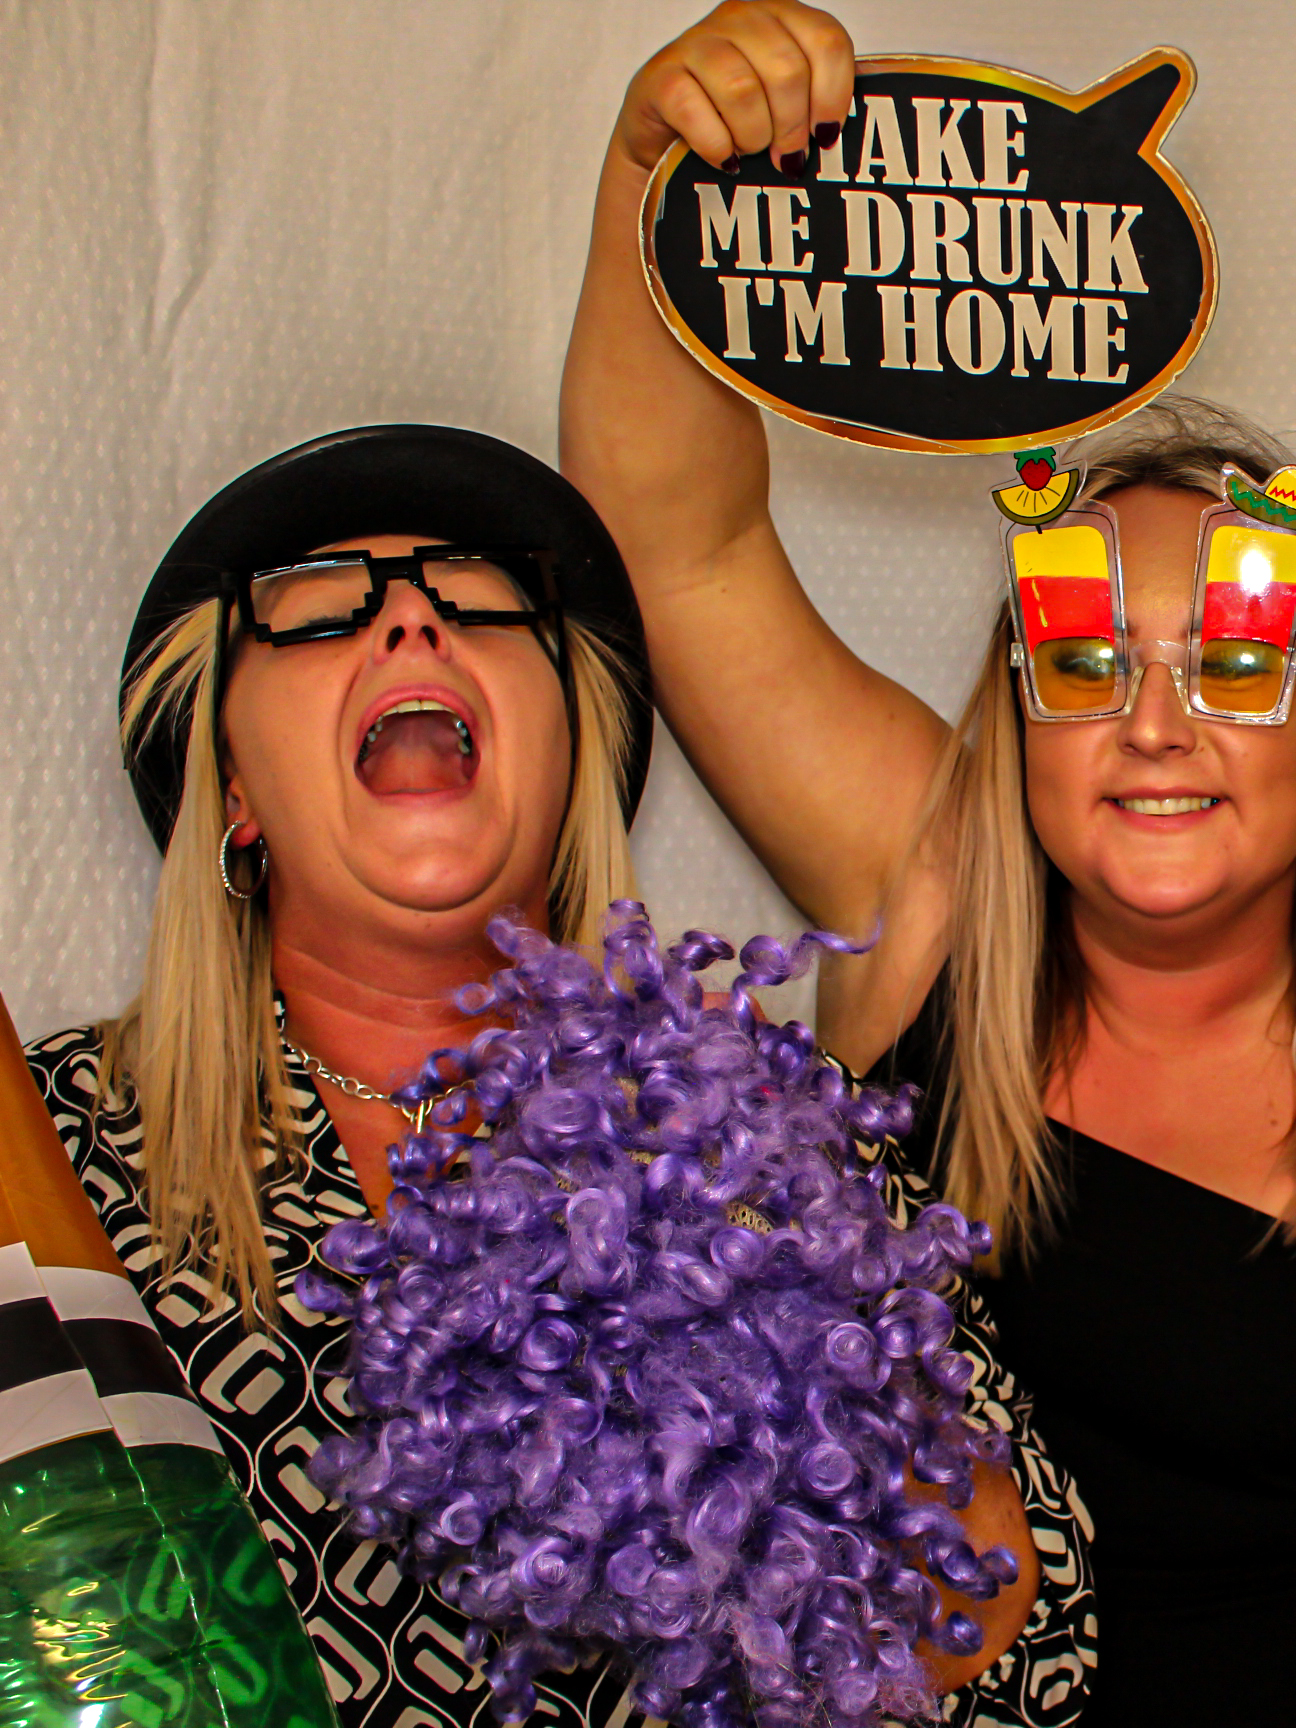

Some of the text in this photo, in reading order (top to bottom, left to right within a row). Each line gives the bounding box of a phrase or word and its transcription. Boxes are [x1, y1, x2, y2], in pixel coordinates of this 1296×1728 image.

[694, 183, 1149, 293] ME DRUNK
[718, 276, 1130, 384] I'M HOME
